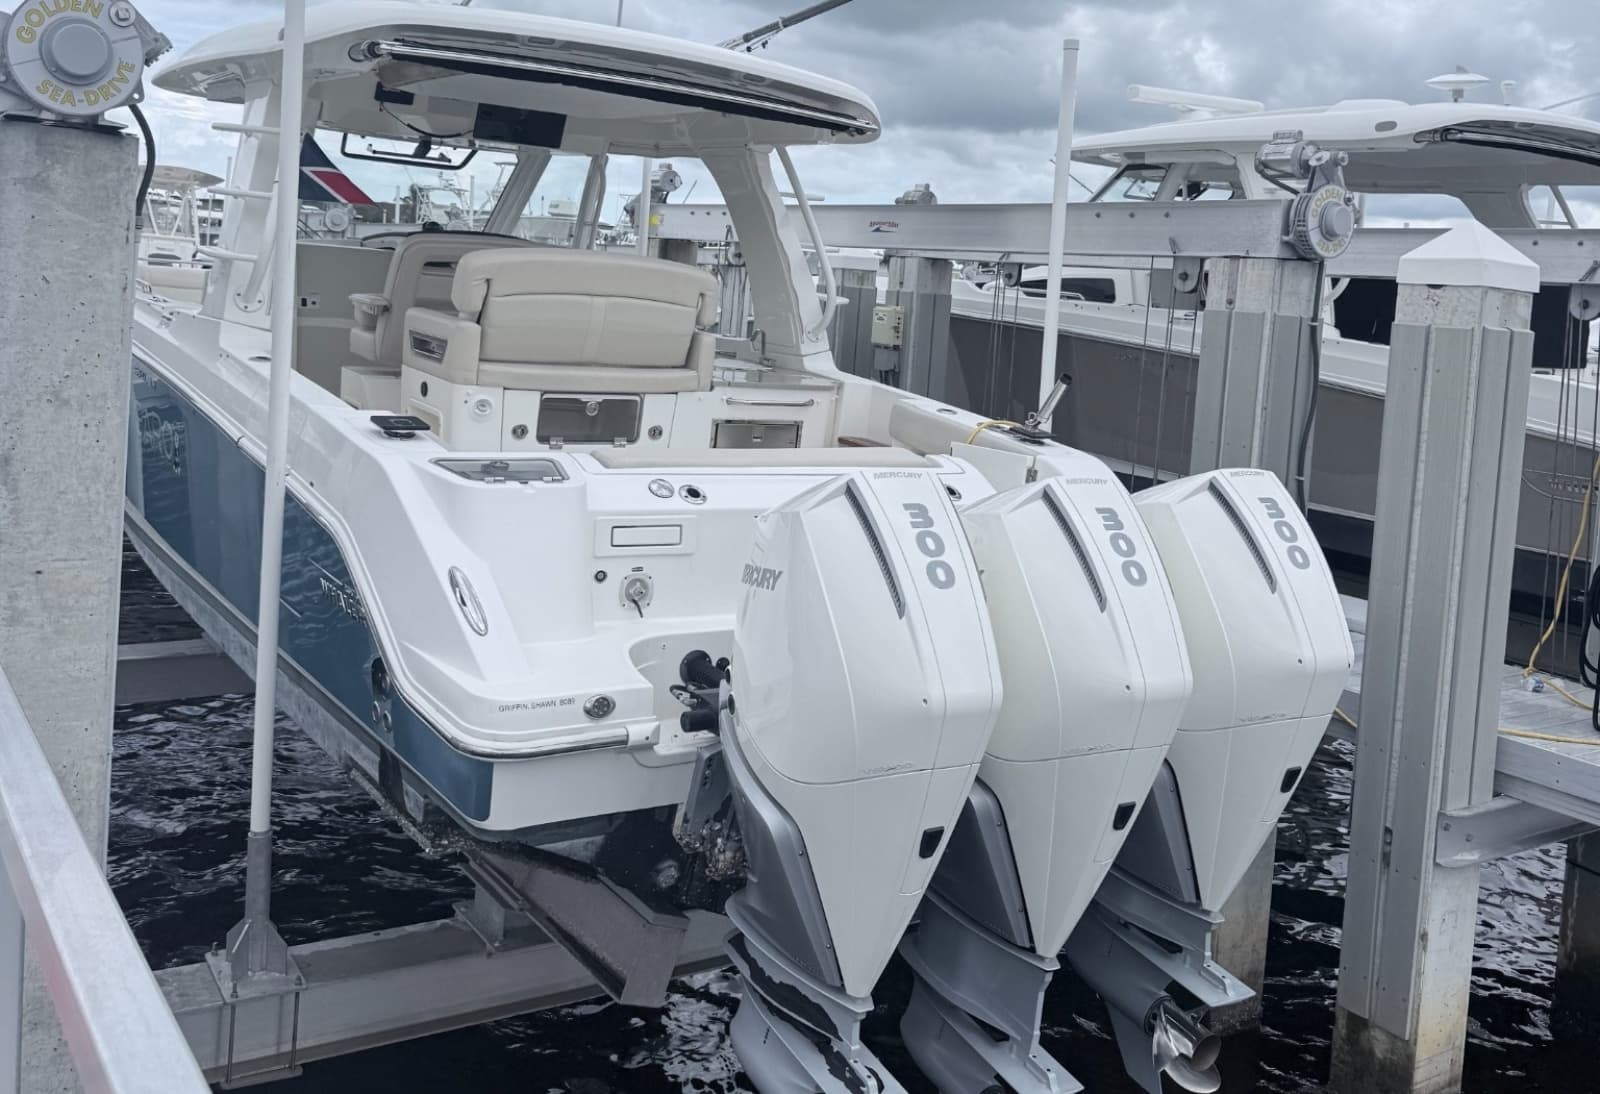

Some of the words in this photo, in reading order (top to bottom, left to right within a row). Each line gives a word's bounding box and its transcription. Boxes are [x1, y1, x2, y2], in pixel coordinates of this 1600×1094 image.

[16, 0, 104, 44] GOLDEN
[37, 61, 135, 107] SEA-DRIVE
[1311, 187, 1343, 218] GOLDEN
[872, 471, 923, 480] MERCURY
[902, 502, 956, 590] 300
[1095, 506, 1148, 587] 300
[1257, 496, 1310, 570] 300
